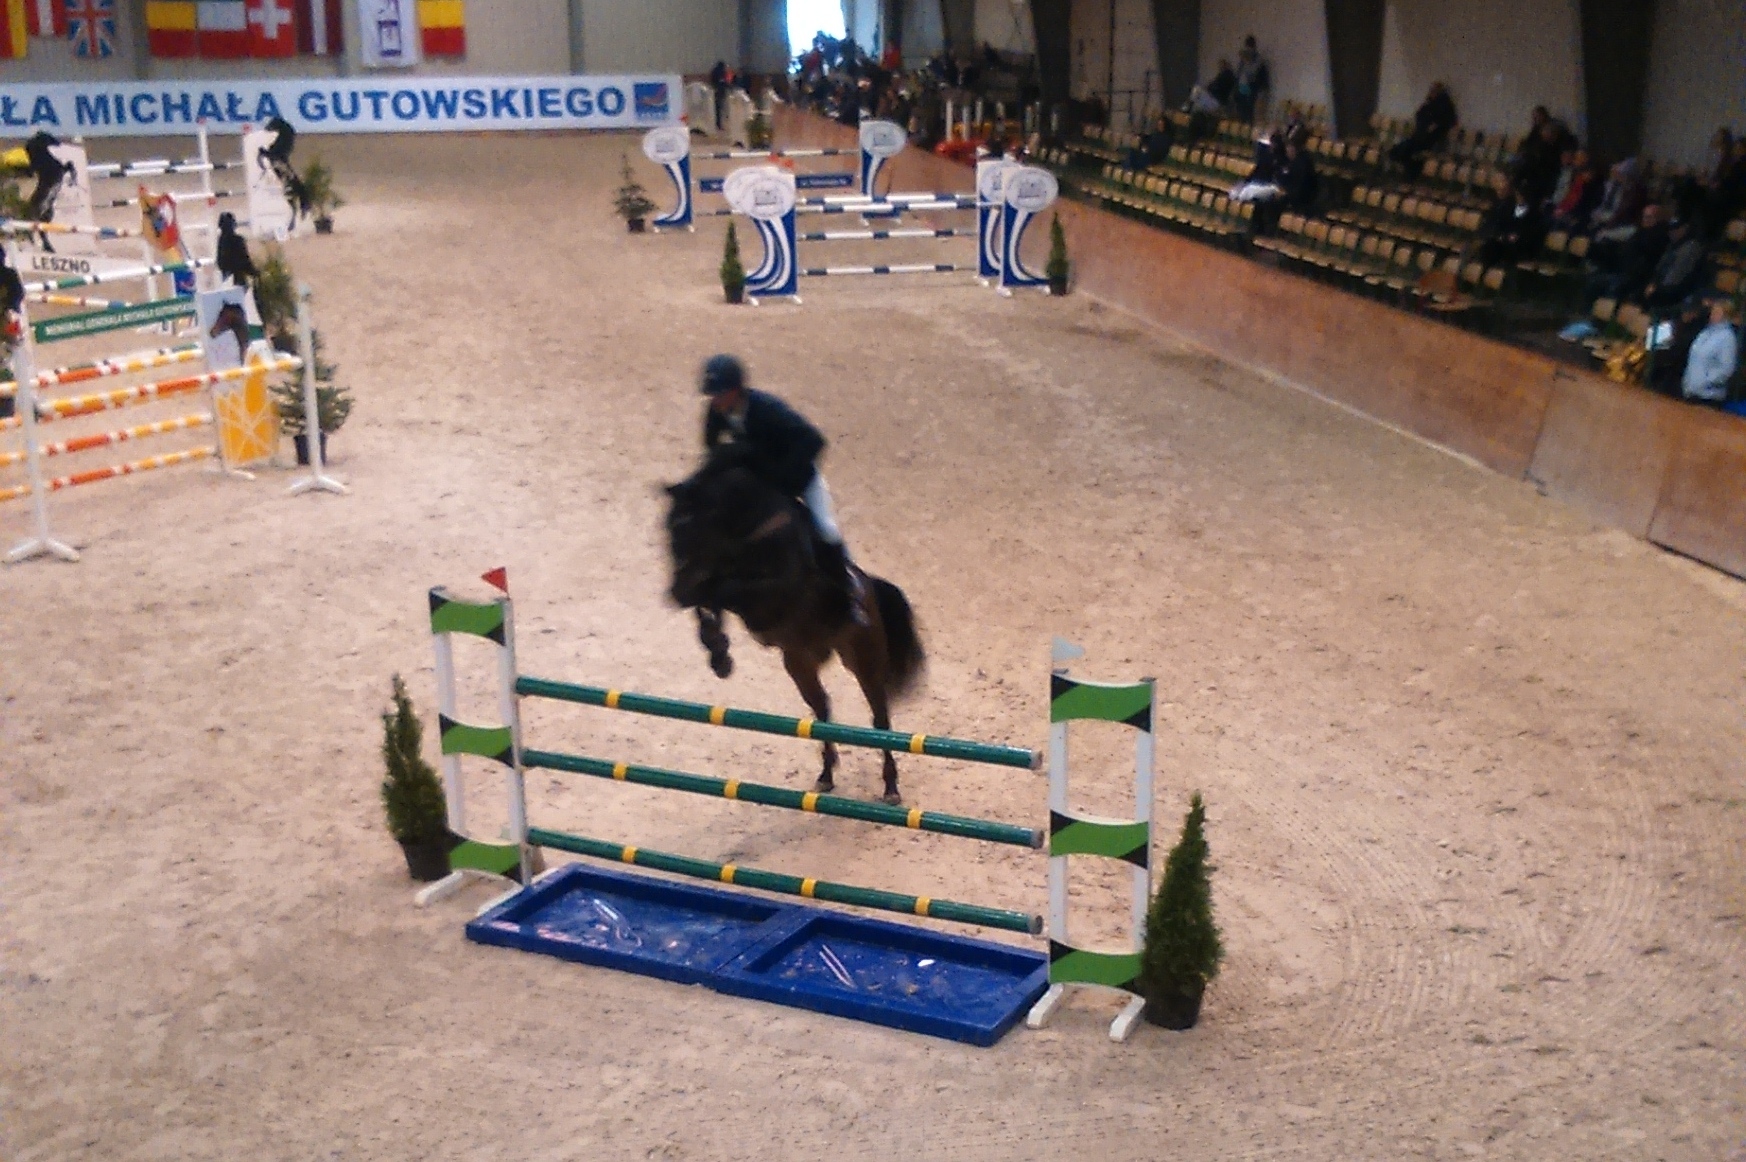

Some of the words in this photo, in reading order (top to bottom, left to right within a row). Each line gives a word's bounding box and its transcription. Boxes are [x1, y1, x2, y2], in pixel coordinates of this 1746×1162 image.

[75, 91, 282, 125] MICHAŁA
[298, 87, 626, 122] GUTOWSKIEGO
[32, 256, 91, 274] LESZNO
